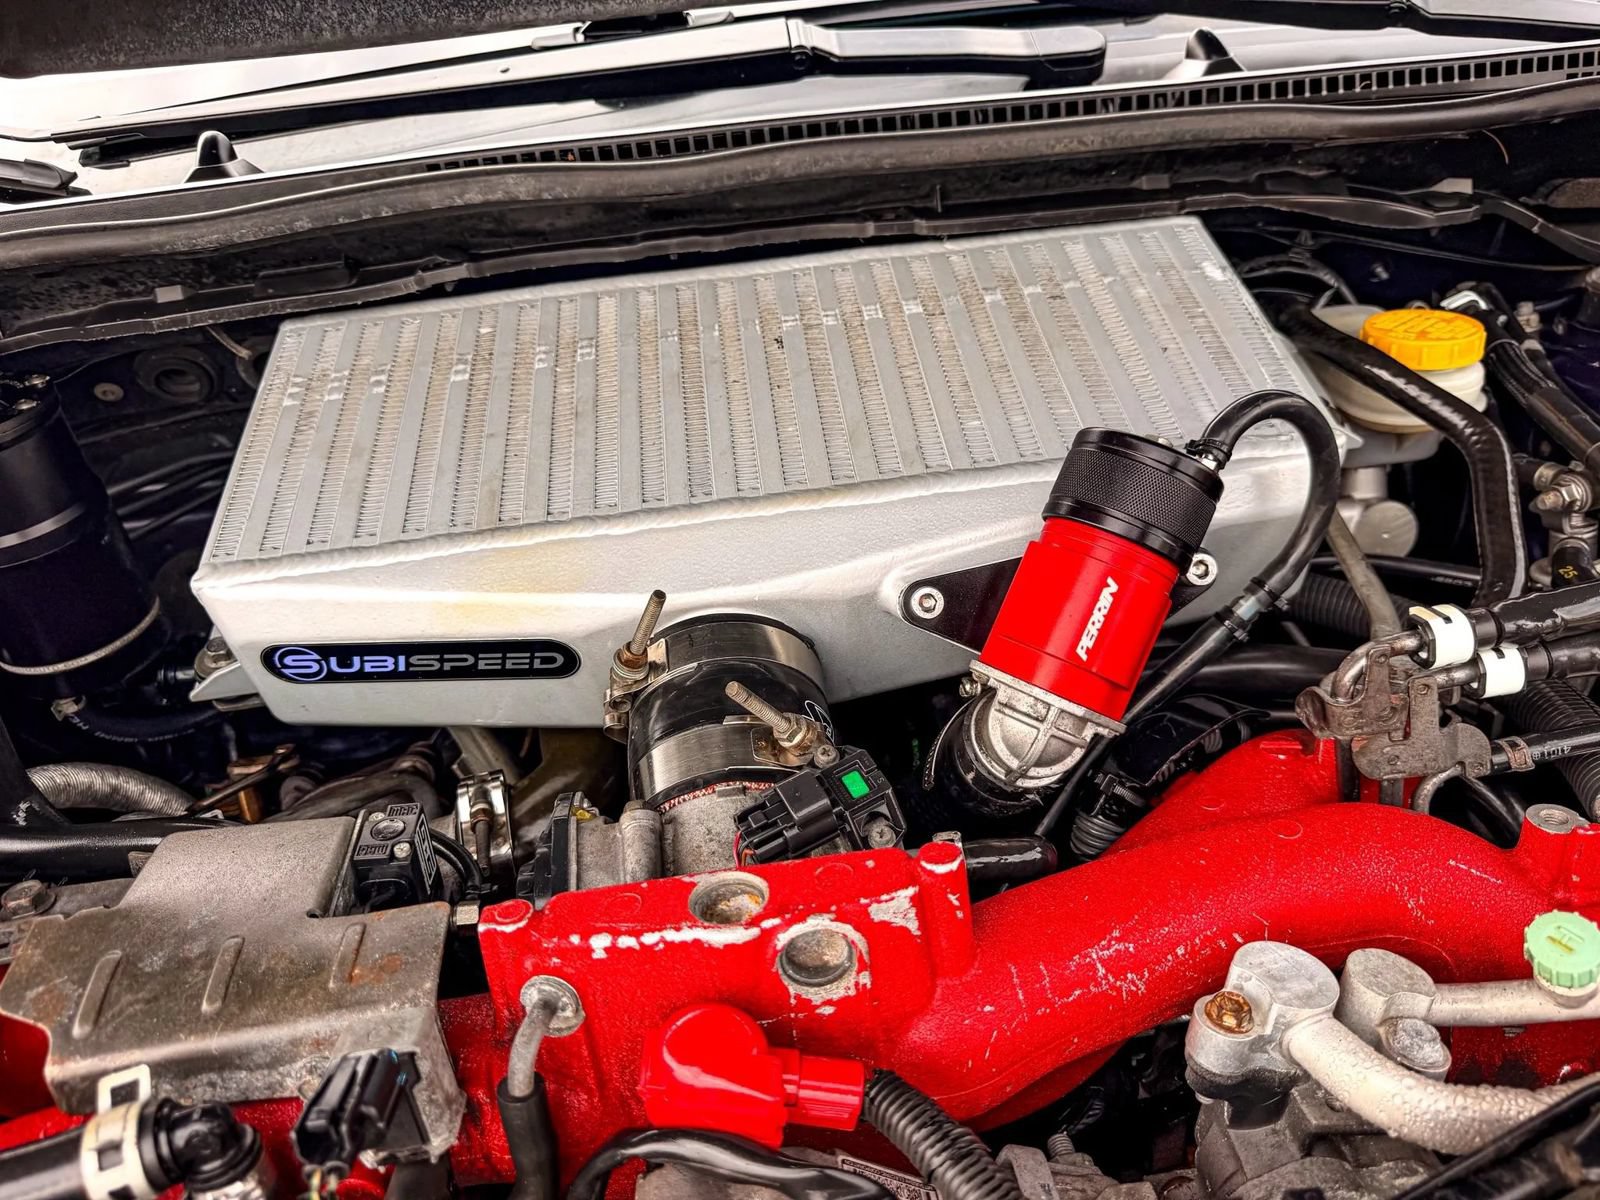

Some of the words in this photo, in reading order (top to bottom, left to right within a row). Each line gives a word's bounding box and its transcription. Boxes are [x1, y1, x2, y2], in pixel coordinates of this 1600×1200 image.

[1558, 565, 1578, 579] 25
[1076, 576, 1119, 662] PERRIN
[277, 647, 564, 681] SUBISPEED
